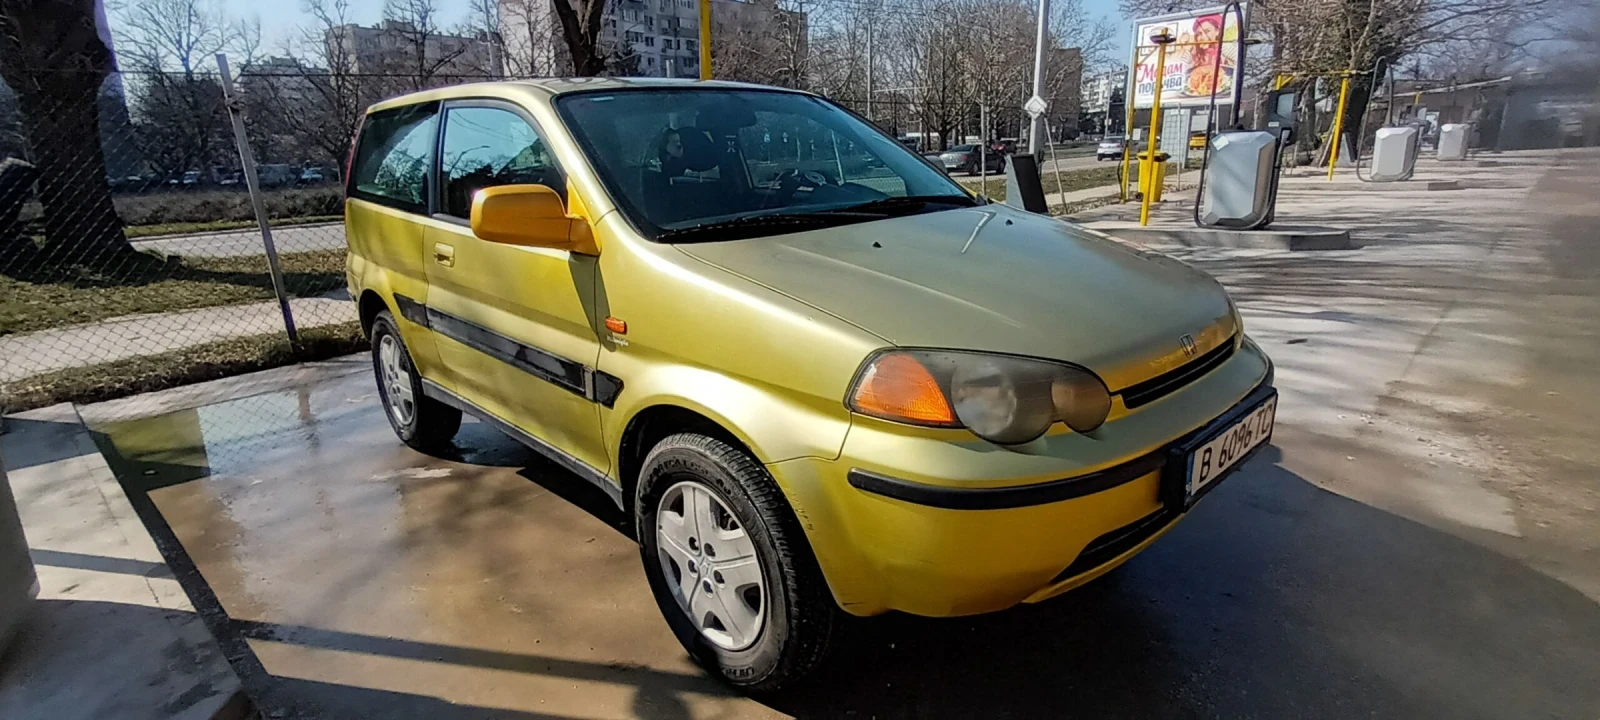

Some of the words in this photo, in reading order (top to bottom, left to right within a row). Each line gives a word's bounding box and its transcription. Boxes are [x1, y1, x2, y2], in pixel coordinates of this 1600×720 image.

[1138, 76, 1183, 95] порчва
[1198, 446, 1212, 483] B
[1218, 417, 1253, 468] 6096
[1255, 403, 1273, 440] TC
